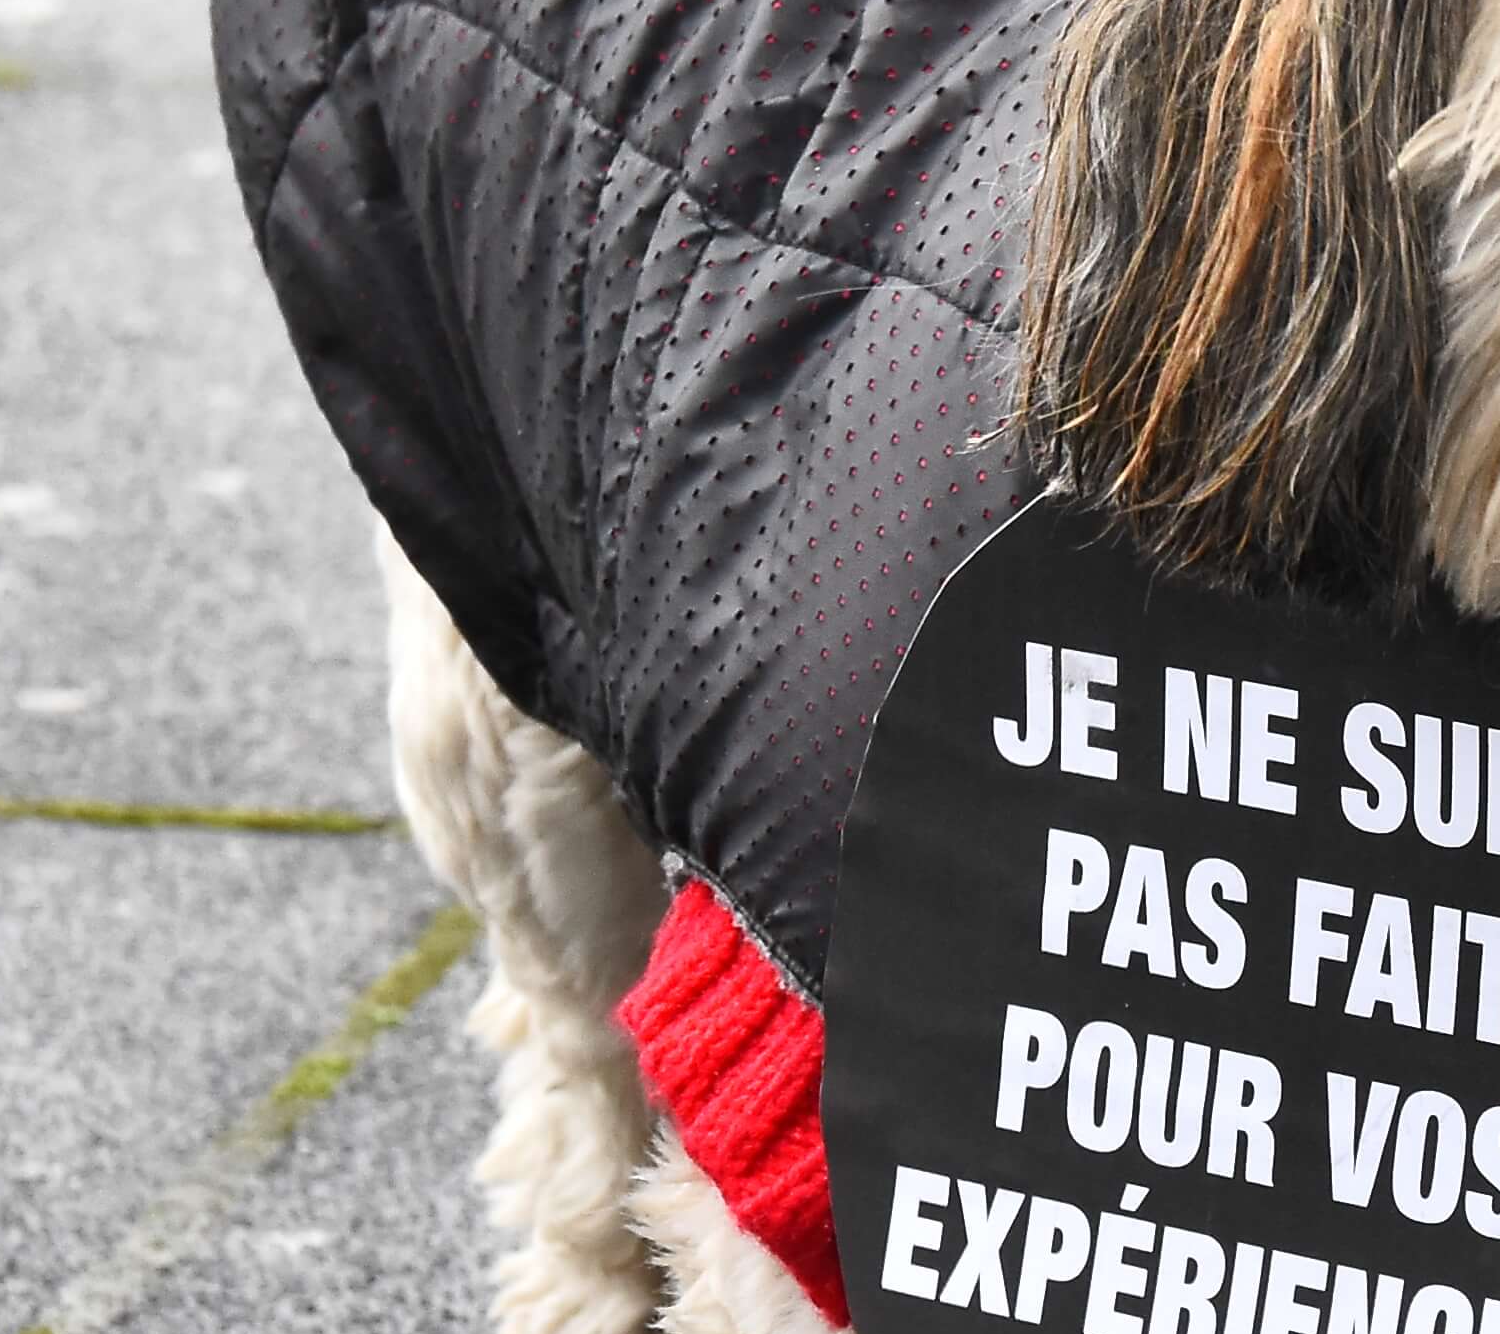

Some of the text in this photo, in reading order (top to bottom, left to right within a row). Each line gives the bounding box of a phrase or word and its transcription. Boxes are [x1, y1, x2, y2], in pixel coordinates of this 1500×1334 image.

[992, 640, 1119, 781] JE
[1162, 665, 1300, 817] NE
[1039, 827, 1248, 991] PAS
[994, 1003, 1283, 1189] POUR
